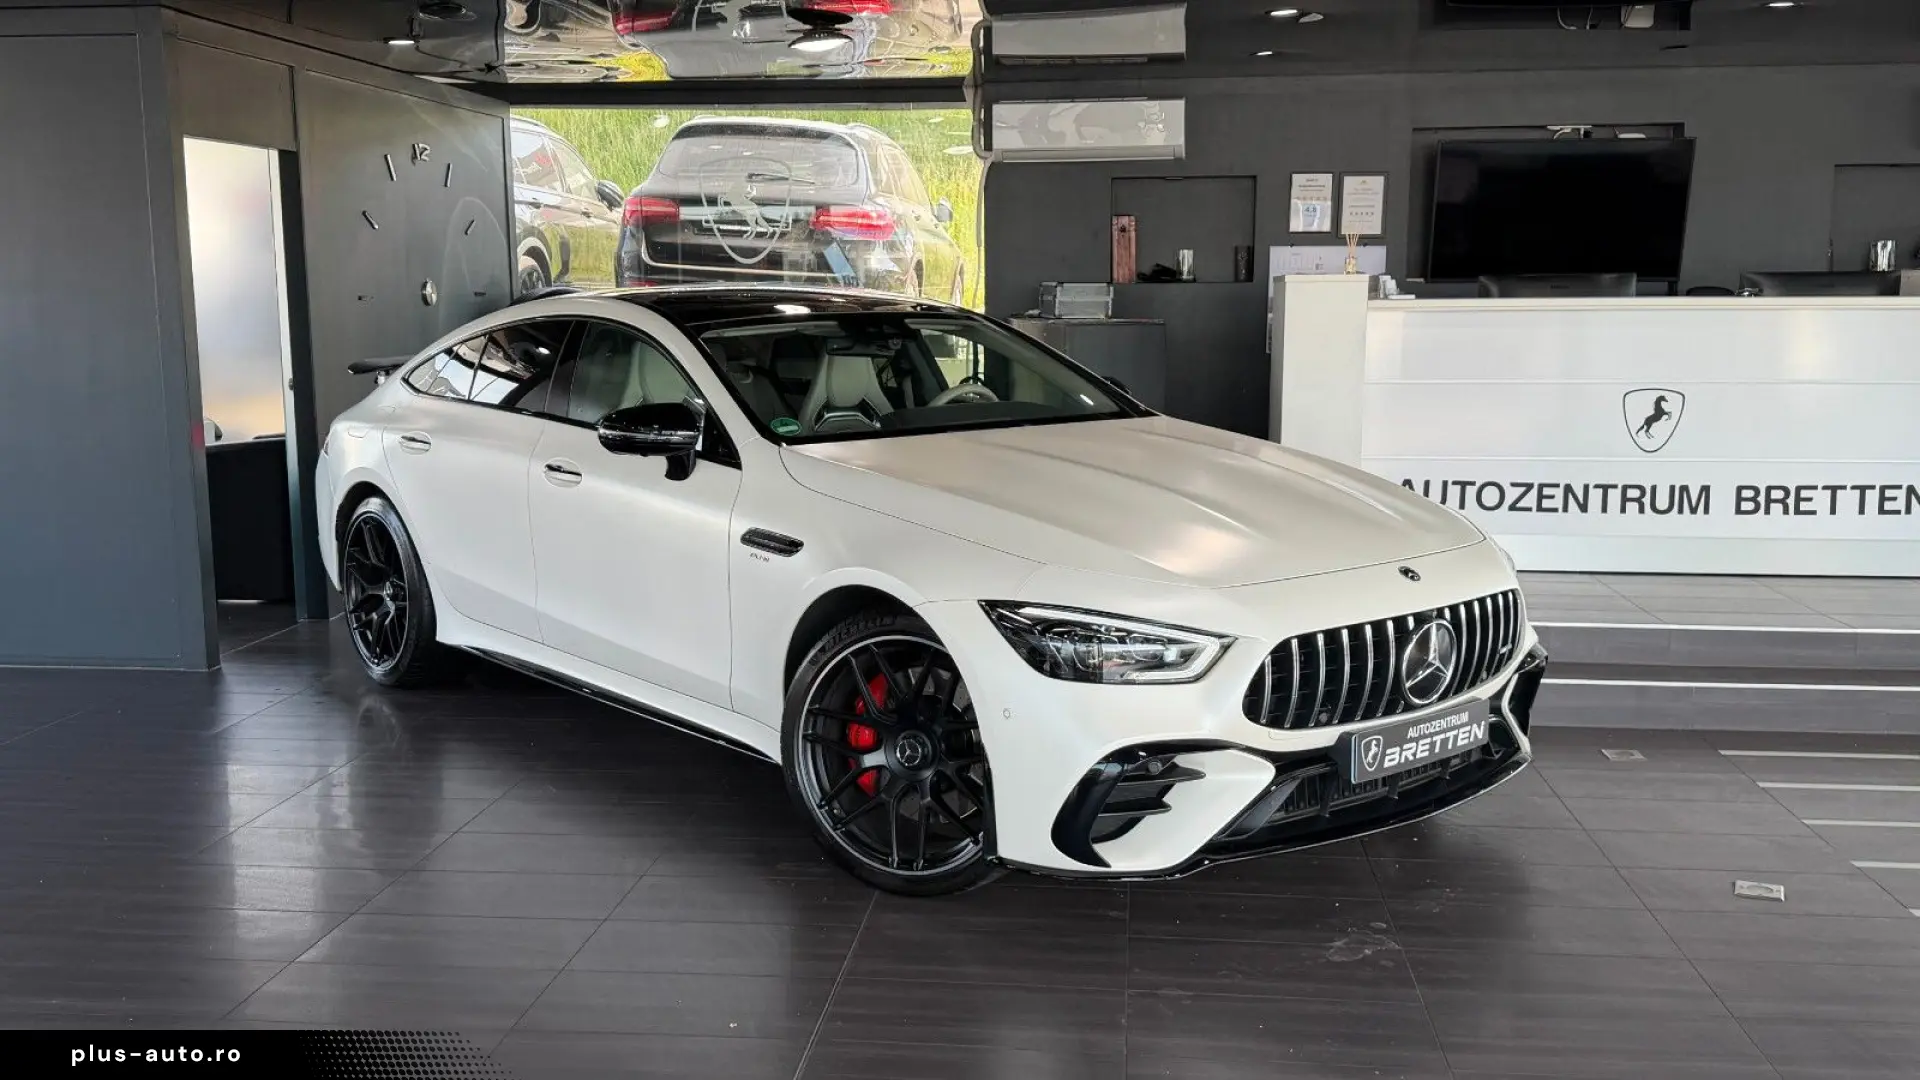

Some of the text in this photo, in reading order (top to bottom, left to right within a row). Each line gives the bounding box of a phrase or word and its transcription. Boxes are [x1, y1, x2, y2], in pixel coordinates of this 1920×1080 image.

[412, 143, 430, 161] 12
[1734, 483, 1920, 515] BRETTEN
[1407, 711, 1469, 739] AUTOZENTRUM
[1383, 721, 1486, 769] BRETTEN
